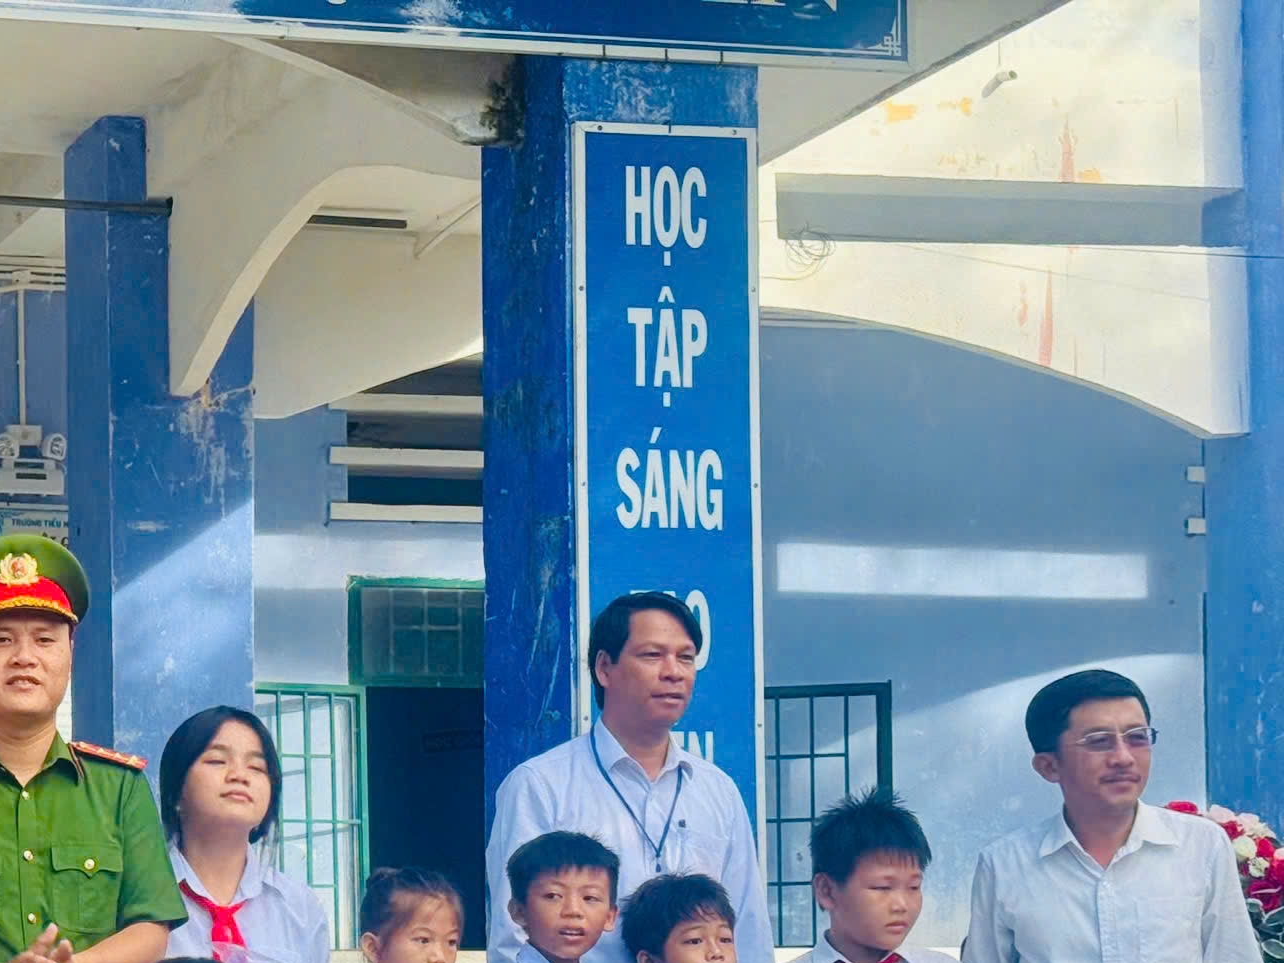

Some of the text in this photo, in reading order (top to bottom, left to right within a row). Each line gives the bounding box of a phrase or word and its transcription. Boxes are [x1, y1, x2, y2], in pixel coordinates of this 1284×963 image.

[625, 165, 708, 268] HỌC
[627, 285, 708, 408] TẬP
[616, 427, 723, 531] SÁNG
